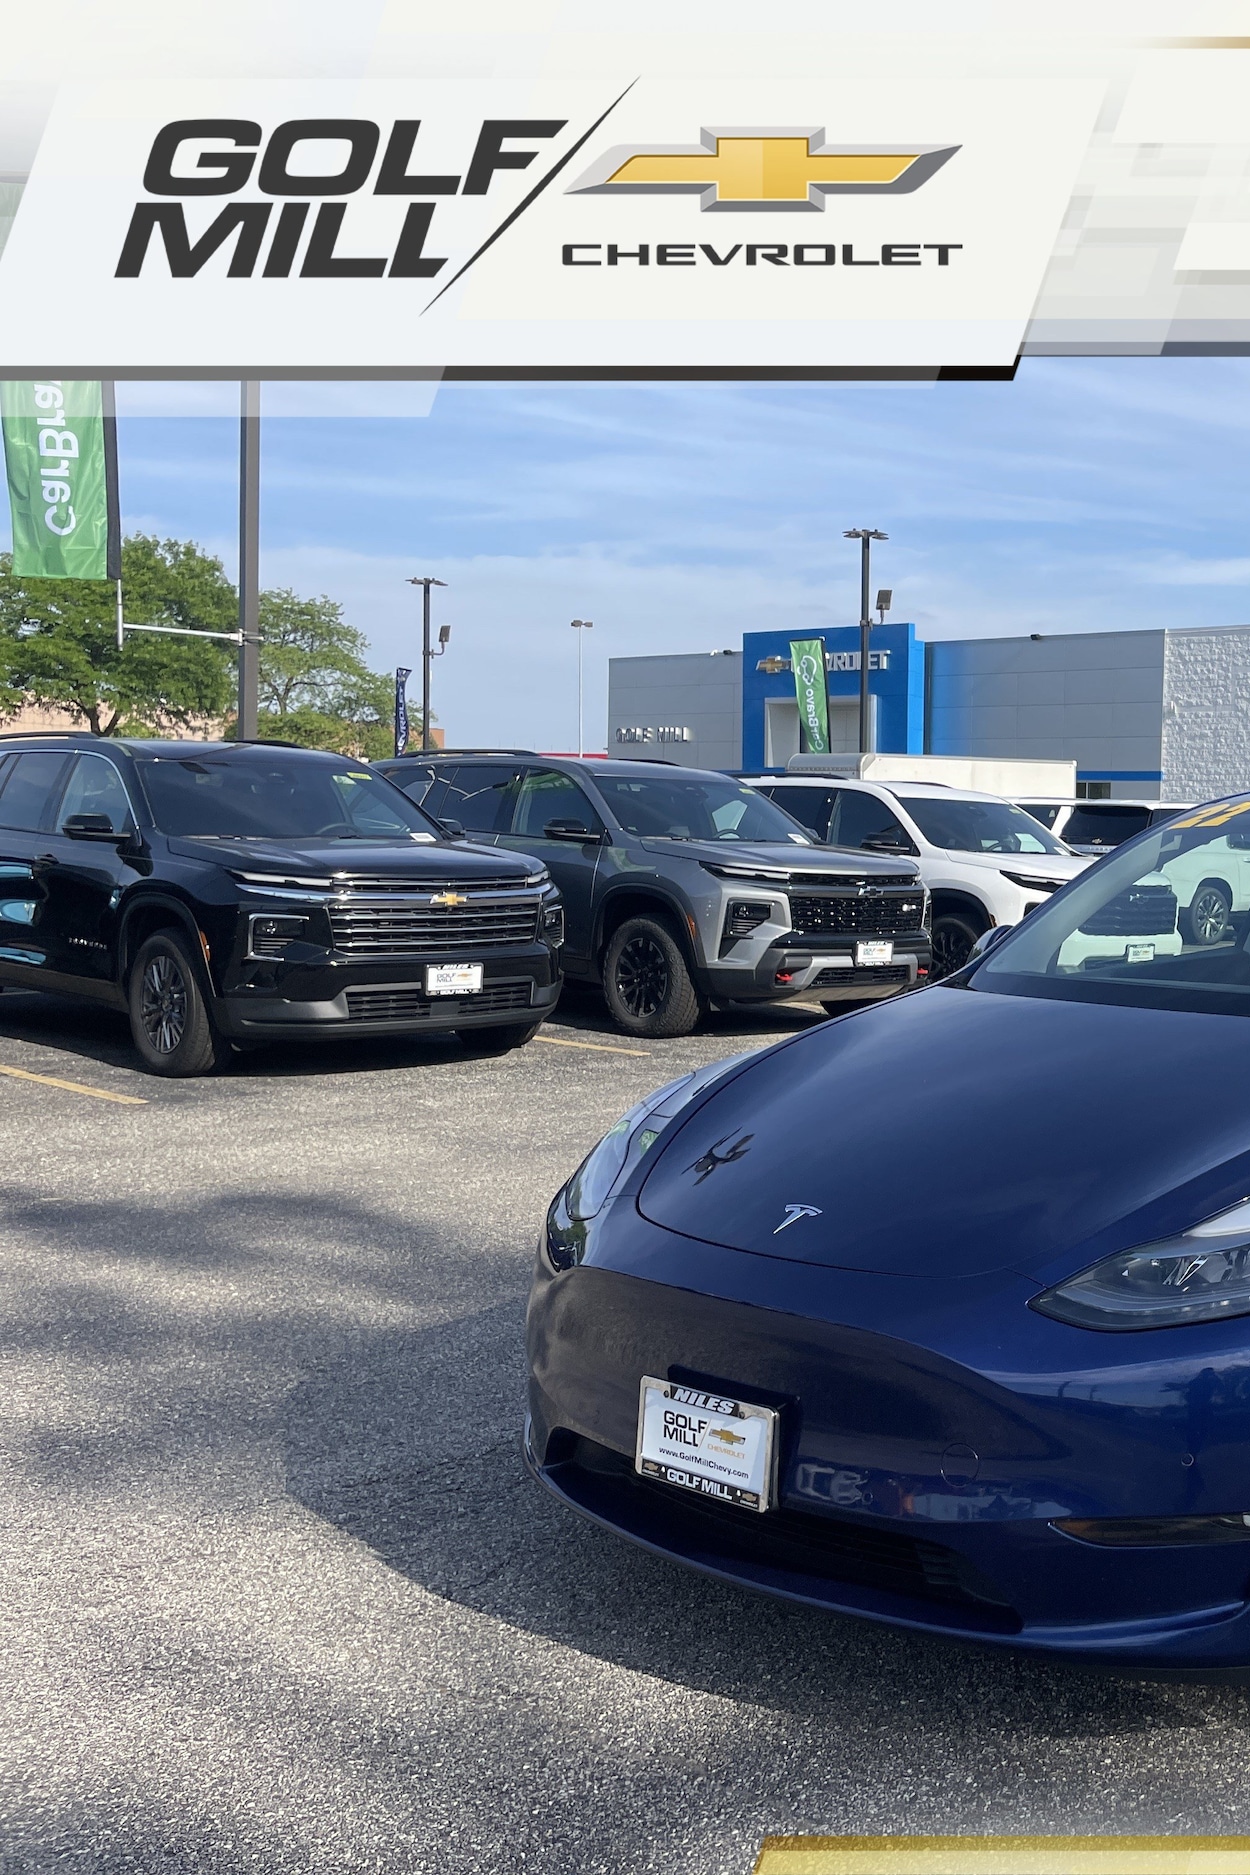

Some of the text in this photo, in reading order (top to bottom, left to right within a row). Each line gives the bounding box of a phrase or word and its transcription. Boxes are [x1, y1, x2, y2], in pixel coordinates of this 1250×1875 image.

[673, 1388, 735, 1414] NILES
[664, 1410, 707, 1434] GOLF
[663, 1424, 699, 1447] MILL
[659, 1447, 749, 1479] www.GolfMillChevy.com
[707, 1443, 746, 1459] CHEVROLET
[666, 1468, 733, 1500] GOLF MILL
